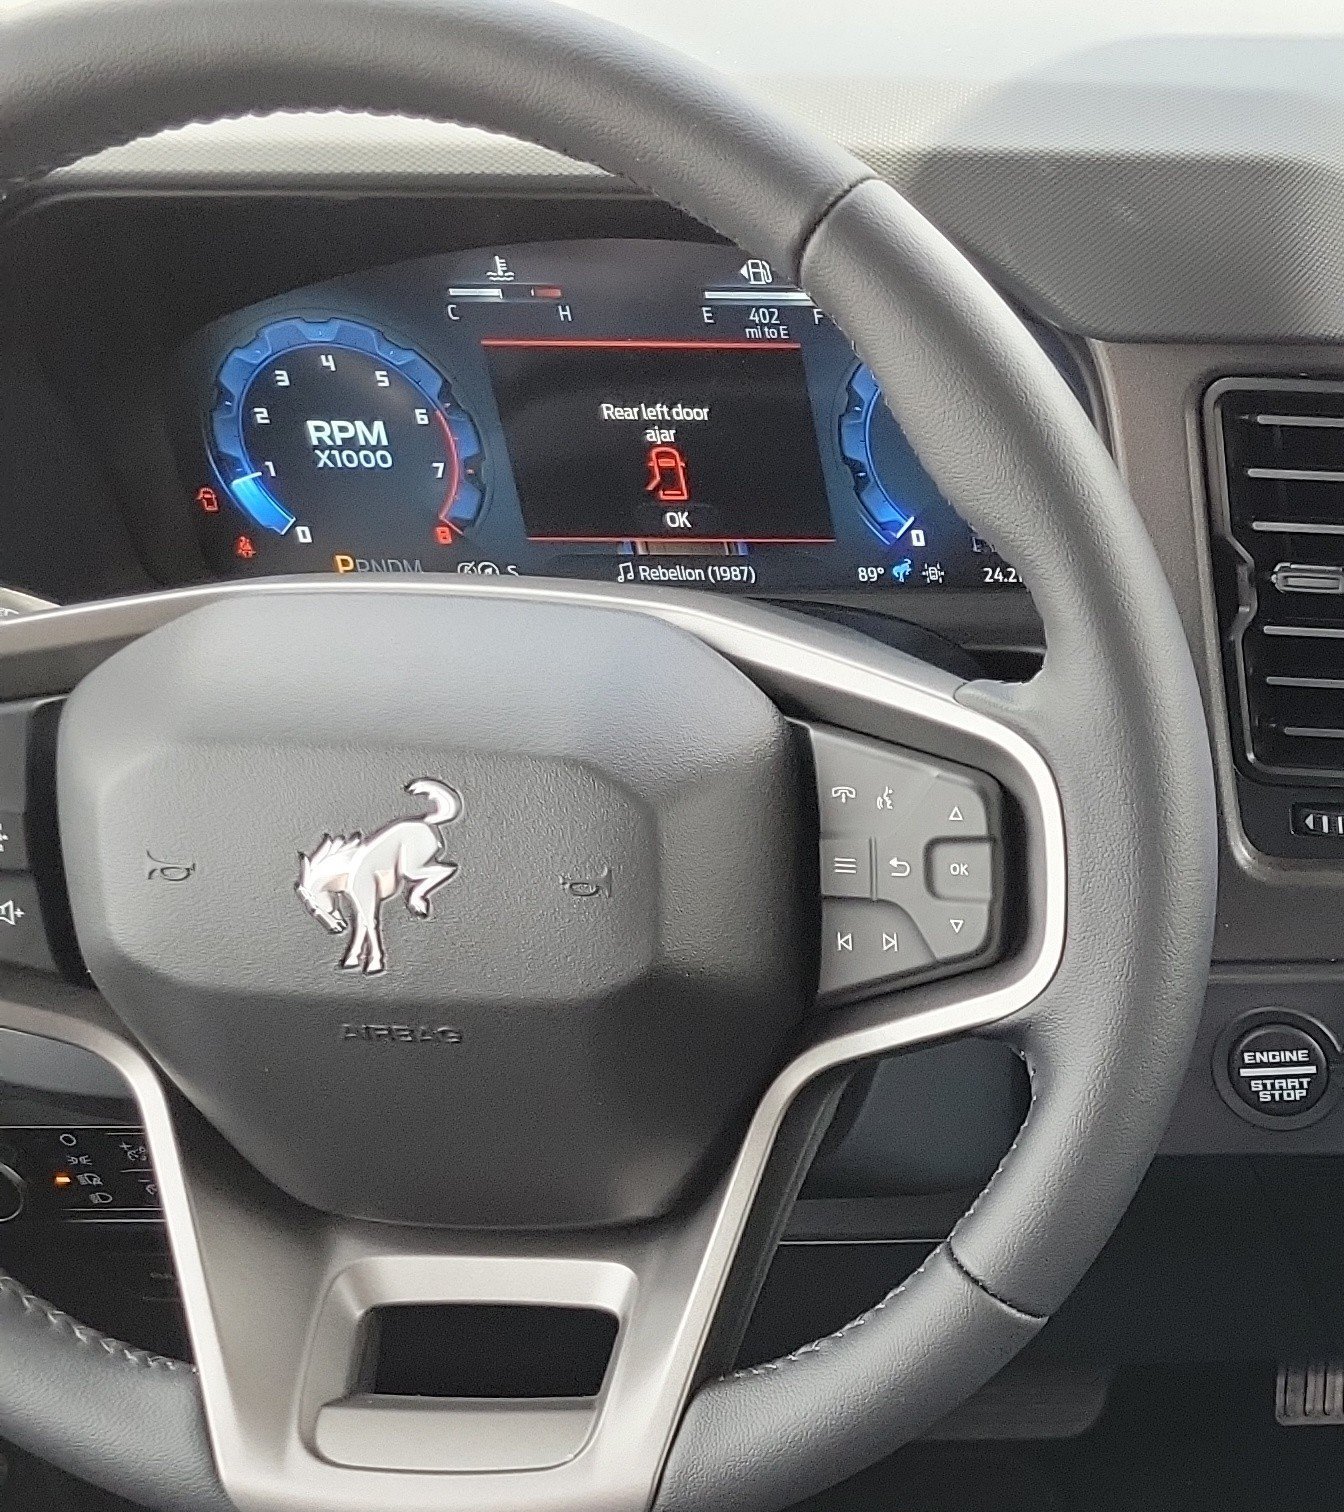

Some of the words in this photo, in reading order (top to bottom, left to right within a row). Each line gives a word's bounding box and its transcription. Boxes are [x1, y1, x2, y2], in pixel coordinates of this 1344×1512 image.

[447, 304, 460, 320] C
[557, 305, 573, 321] H
[701, 306, 715, 324] E
[748, 308, 780, 324] 402
[812, 309, 824, 325] F
[764, 327, 777, 339] to
[780, 326, 789, 339] E
[320, 354, 336, 371] 4
[275, 370, 290, 386] 3
[374, 370, 390, 387] 5
[253, 407, 270, 424] 2
[414, 408, 429, 425] 6
[601, 403, 640, 420] Rear
[641, 403, 670, 420] left
[672, 403, 710, 421] door
[306, 419, 390, 446] RPM
[645, 426, 676, 444] ajar
[313, 450, 393, 469] X1000
[264, 461, 276, 477] 1
[431, 462, 445, 478] 7
[665, 511, 692, 528] OK
[296, 526, 313, 543] 0
[911, 530, 926, 546] 0
[708, 565, 755, 583] (1987)
[949, 862, 969, 876] OK
[1243, 1049, 1310, 1064] ENGINE
[1250, 1077, 1311, 1091] START
[1258, 1089, 1307, 1102] STOP
